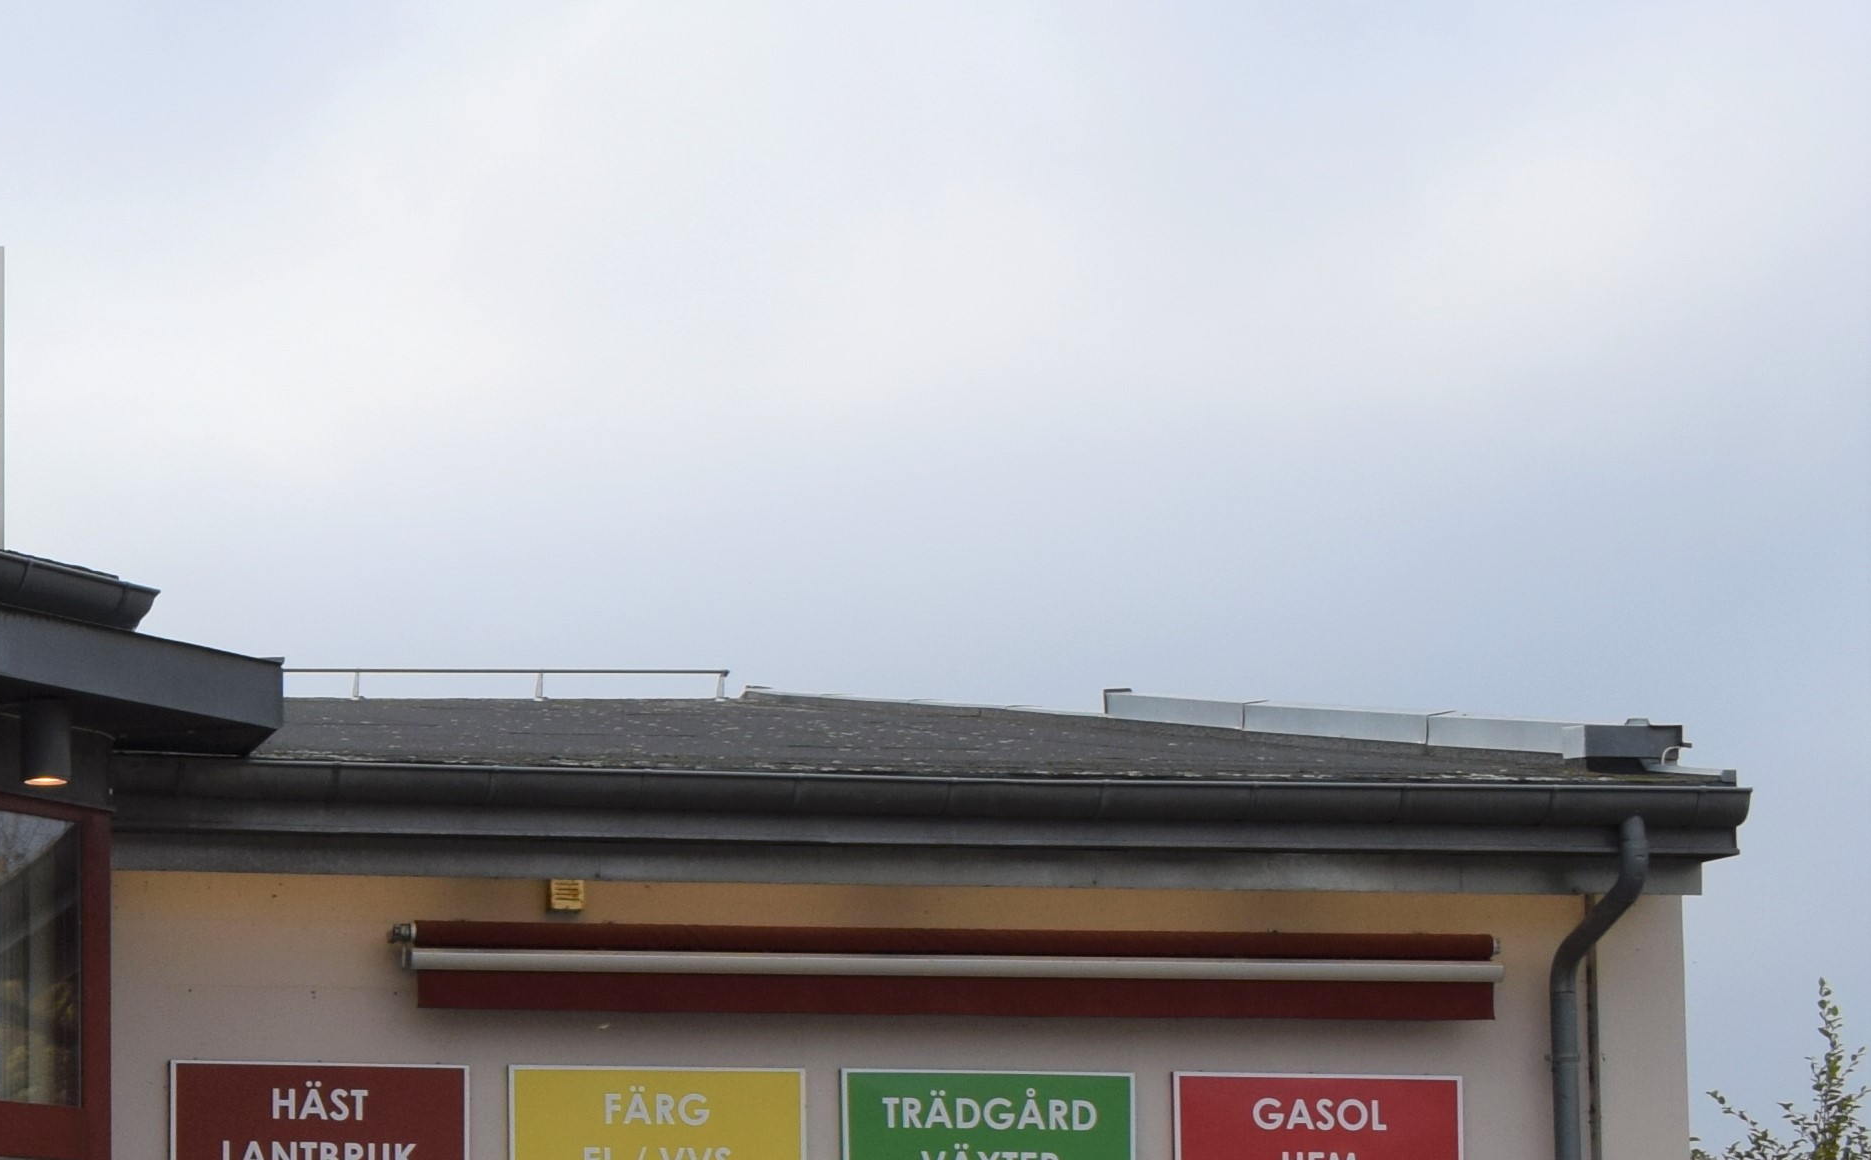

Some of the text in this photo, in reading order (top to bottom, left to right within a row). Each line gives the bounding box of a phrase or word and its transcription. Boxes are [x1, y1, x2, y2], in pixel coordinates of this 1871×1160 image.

[273, 1081, 368, 1121] HÄST
[605, 1086, 710, 1126] FÄRG
[882, 1088, 1097, 1130] TRÄDGÅRD
[1253, 1098, 1387, 1131] GASOL
